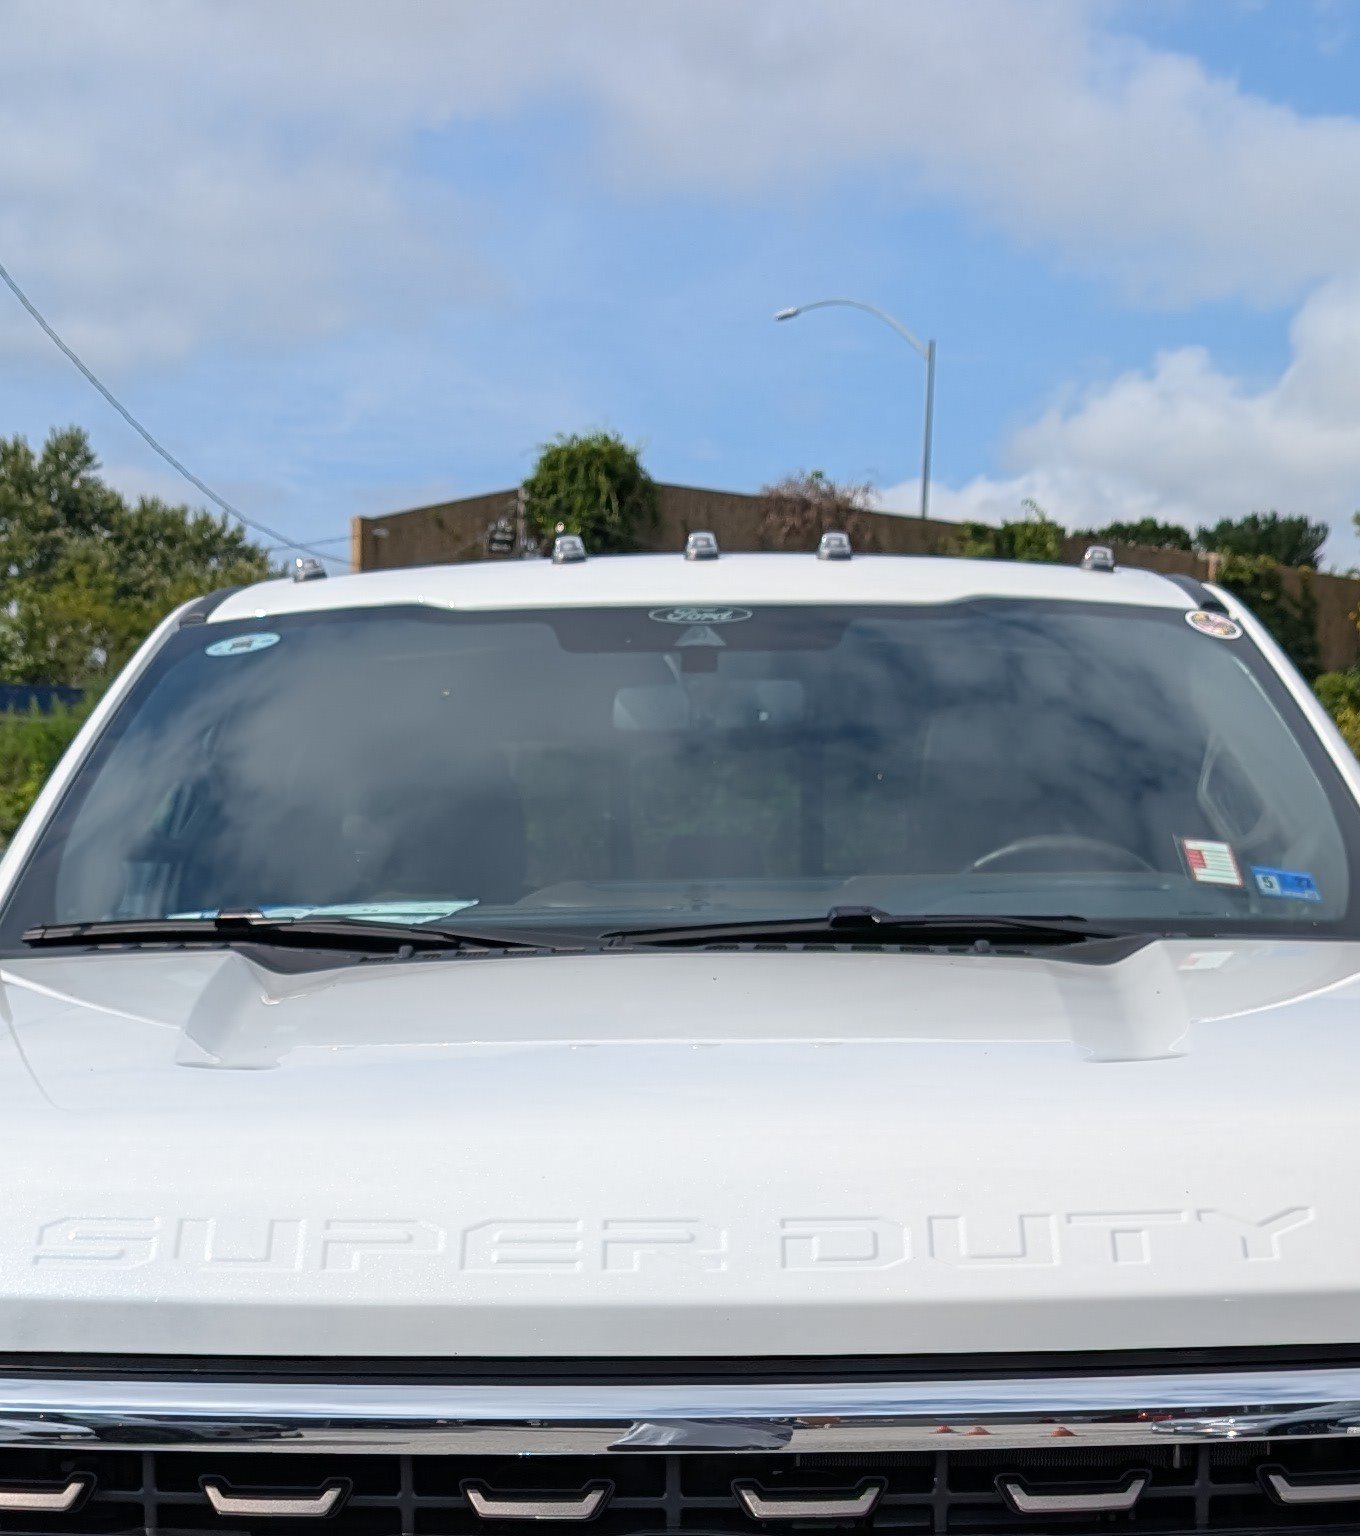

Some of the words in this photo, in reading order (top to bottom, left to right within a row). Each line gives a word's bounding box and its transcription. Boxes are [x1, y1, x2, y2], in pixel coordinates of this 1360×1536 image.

[667, 605, 733, 620] Ford
[32, 1216, 729, 1273] SUPER
[779, 1206, 1316, 1270] DUTY
